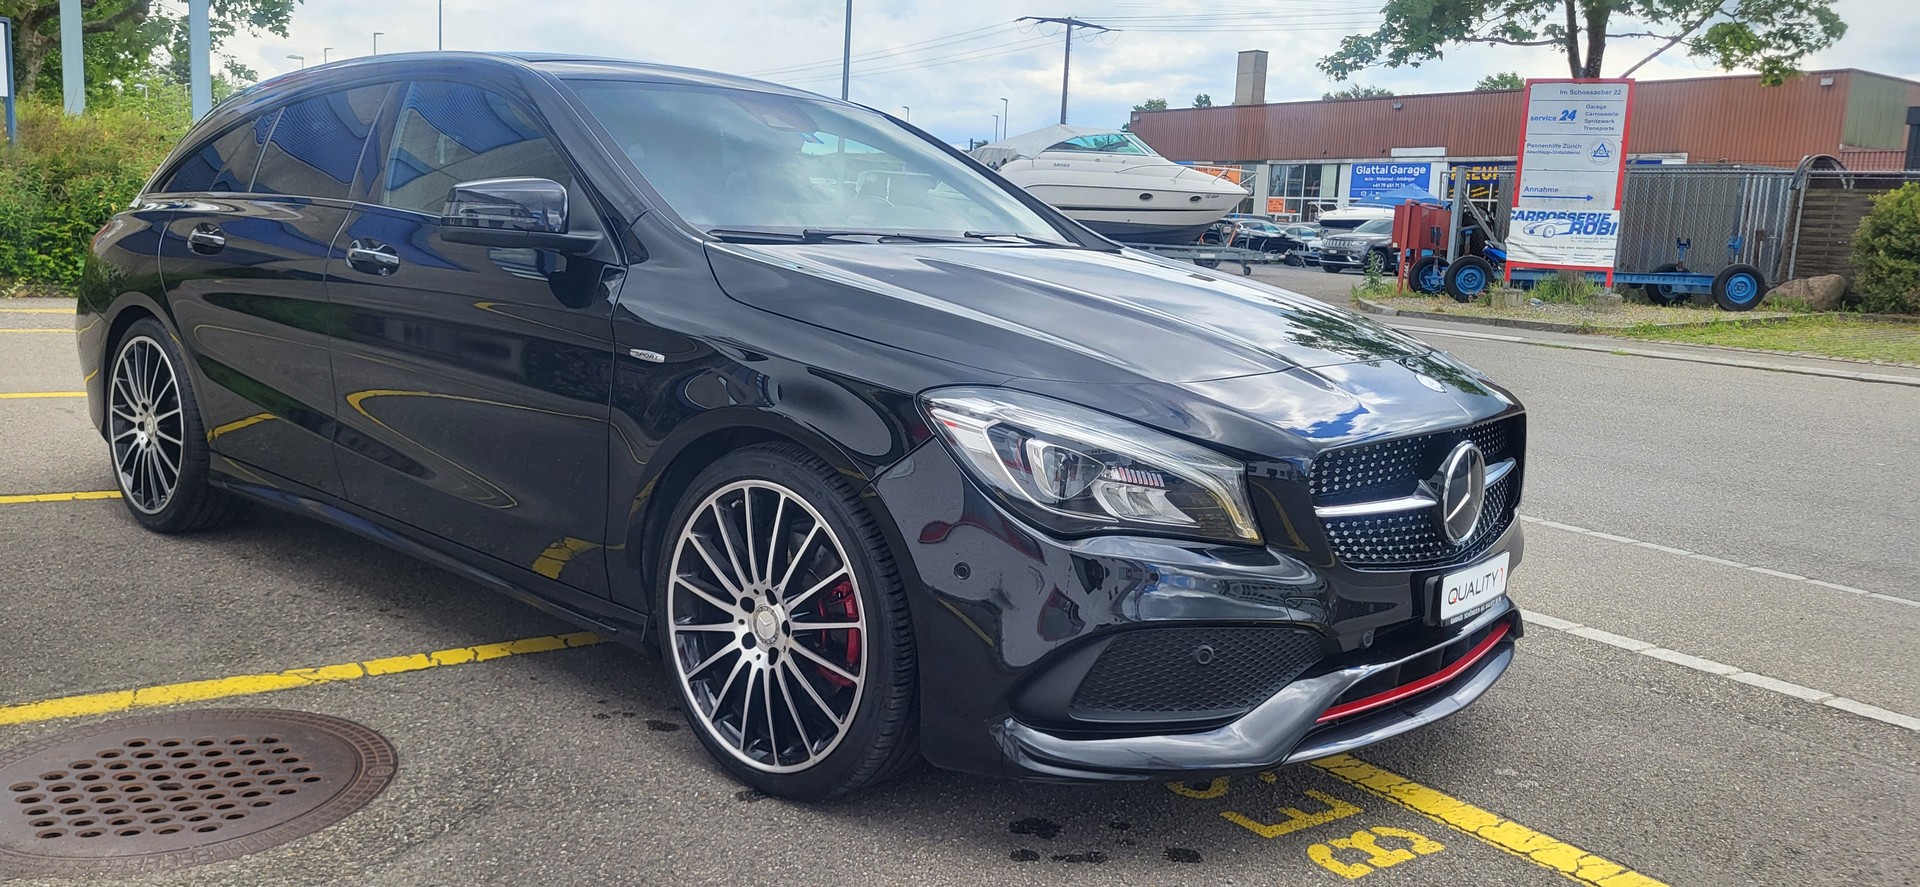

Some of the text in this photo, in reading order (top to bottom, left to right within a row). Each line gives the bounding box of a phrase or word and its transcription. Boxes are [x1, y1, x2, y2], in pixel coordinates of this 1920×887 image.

[1558, 109, 1578, 122] 24
[1356, 165, 1426, 176] Glattal Garage
[1510, 210, 1612, 223] CARROSSERIE
[1568, 222, 1618, 236] ROBI
[634, 351, 658, 360] SPORT
